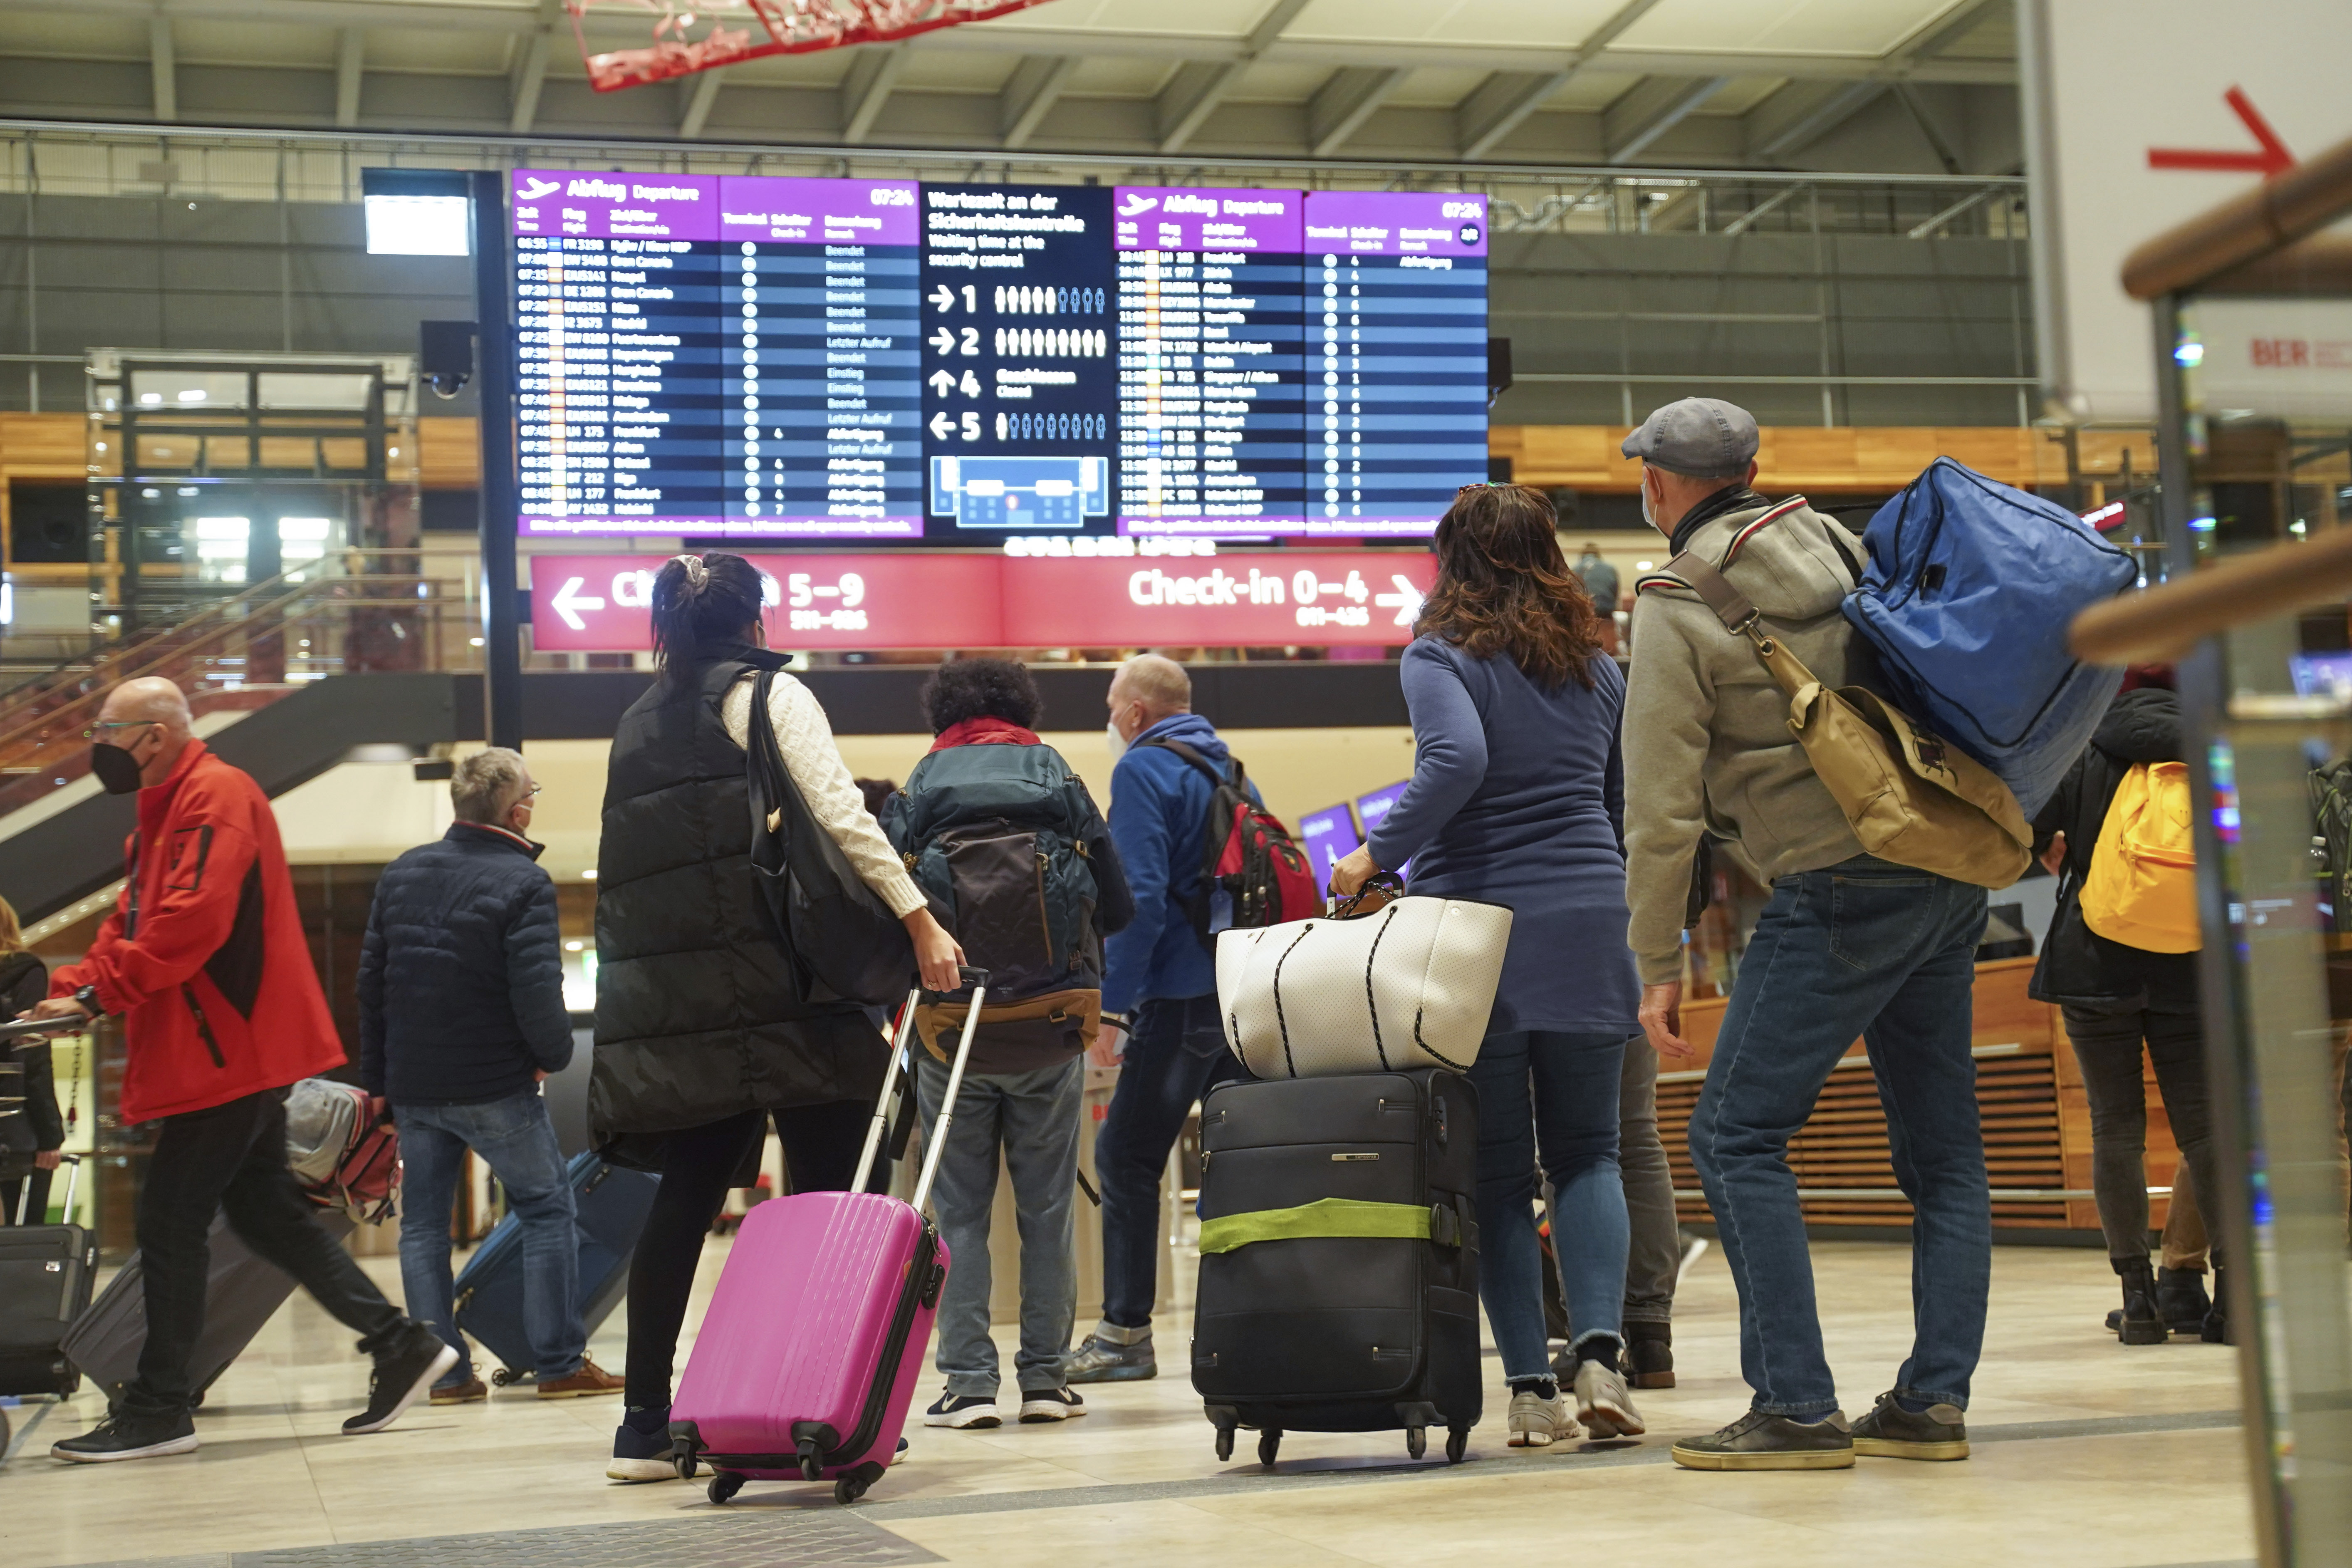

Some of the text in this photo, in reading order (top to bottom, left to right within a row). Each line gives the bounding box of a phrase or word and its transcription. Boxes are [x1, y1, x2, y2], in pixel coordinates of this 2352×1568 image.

[567, 179, 699, 202] Abflug Departure
[871, 189, 914, 206] 07:24
[928, 192, 1057, 210] Wartezeit an der
[1163, 195, 1284, 217] Abflug Departure
[1442, 202, 1483, 218] 07:24
[928, 212, 1084, 232] Sicherheitskontrolle
[929, 234, 1045, 250] Waiting time at the
[826, 245, 864, 256] Beendet
[826, 261, 864, 272] Beendet
[929, 253, 1024, 269] security control
[826, 276, 865, 287] Beendet
[826, 291, 865, 302] Beendet
[962, 285, 975, 312] 1
[827, 307, 865, 317] Beendet
[827, 322, 865, 333] Beendet
[961, 327, 979, 355] 2
[827, 352, 866, 363] Beendet
[2251, 337, 2308, 369] BER
[960, 370, 980, 398] 4
[828, 398, 867, 409] Beendet
[962, 412, 980, 441] 5
[1129, 568, 1285, 605] Check-in
